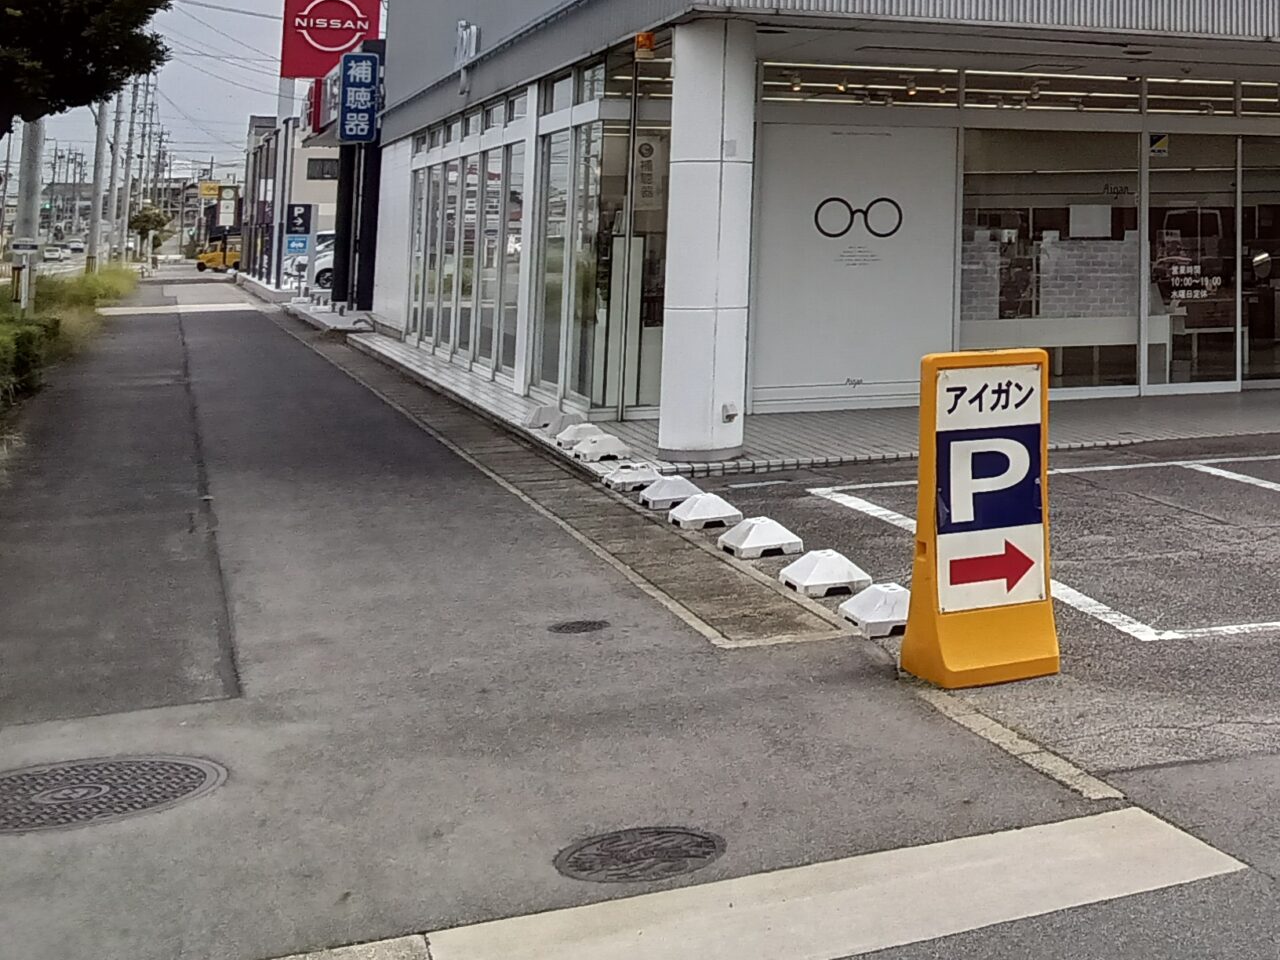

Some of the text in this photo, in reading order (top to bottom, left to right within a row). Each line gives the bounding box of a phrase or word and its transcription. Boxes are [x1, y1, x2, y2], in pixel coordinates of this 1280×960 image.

[295, 17, 369, 30] NISSAN
[345, 60, 372, 135] 補聴器
[1103, 184, 1128, 199] Aigan
[294, 206, 304, 217] P
[946, 380, 1035, 414] アイガン
[950, 438, 1030, 524] P
